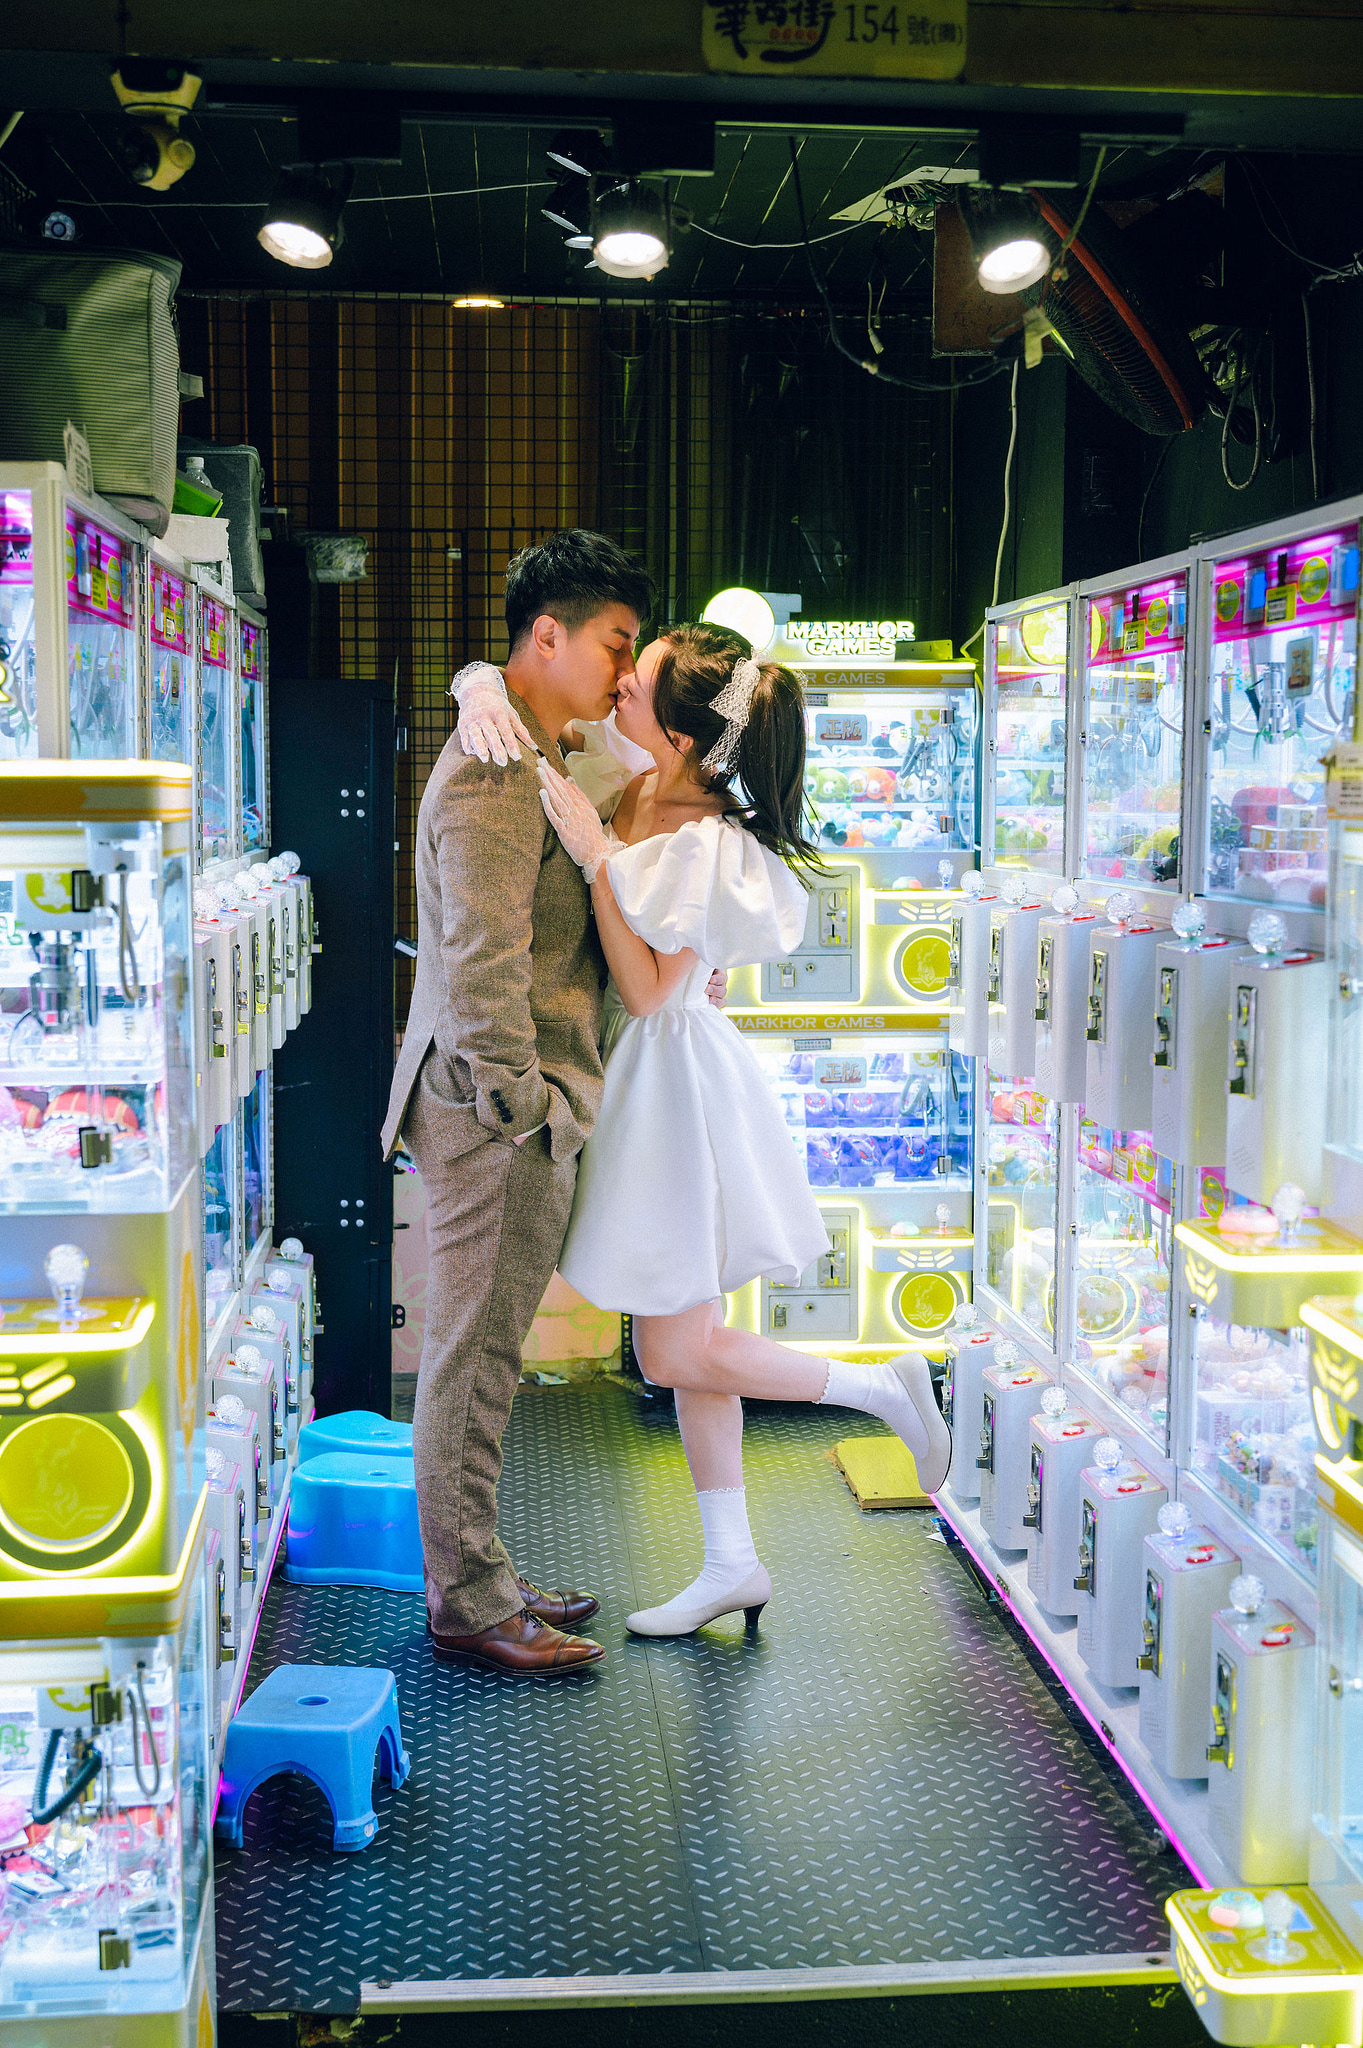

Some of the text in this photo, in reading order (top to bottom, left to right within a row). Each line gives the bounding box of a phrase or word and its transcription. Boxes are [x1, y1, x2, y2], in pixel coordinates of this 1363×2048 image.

[845, 4, 899, 45] 154
[786, 620, 916, 640] MARKHOR
[806, 638, 897, 656] GAMES
[824, 672, 886, 684] GAMES
[823, 718, 862, 740] 正版
[730, 1016, 885, 1029] MARKHOR GAMES
[823, 1062, 862, 1083] 正版
